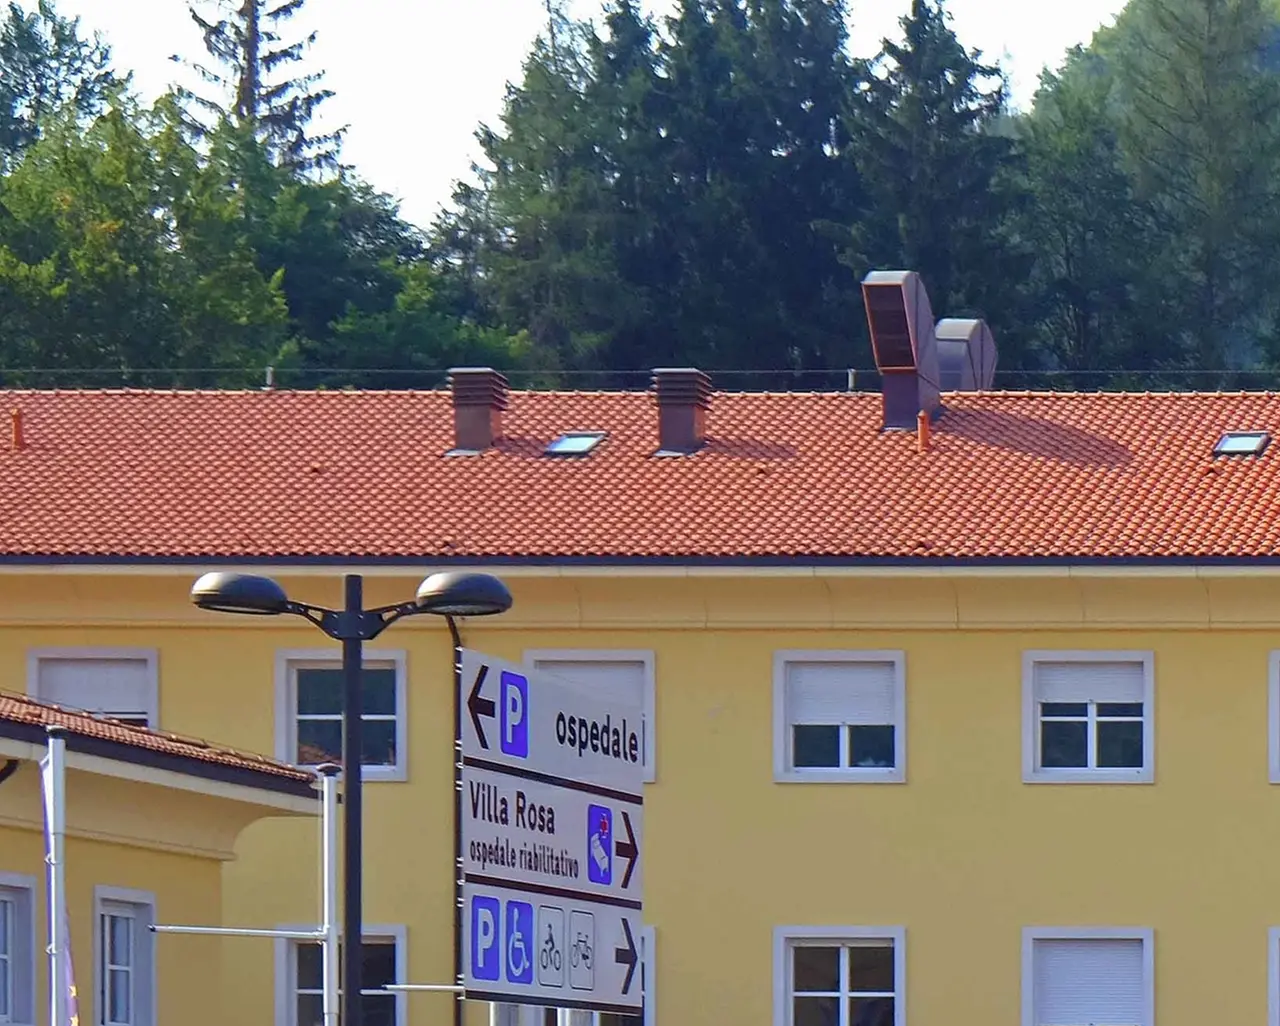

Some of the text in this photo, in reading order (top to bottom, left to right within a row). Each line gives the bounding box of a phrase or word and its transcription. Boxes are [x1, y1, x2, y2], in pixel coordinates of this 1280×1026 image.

[505, 683, 639, 764] P ospedale
[469, 780, 556, 835] Villa Rosa
[469, 836, 579, 879] ospedale riabilitativo
[478, 908, 495, 968] P
